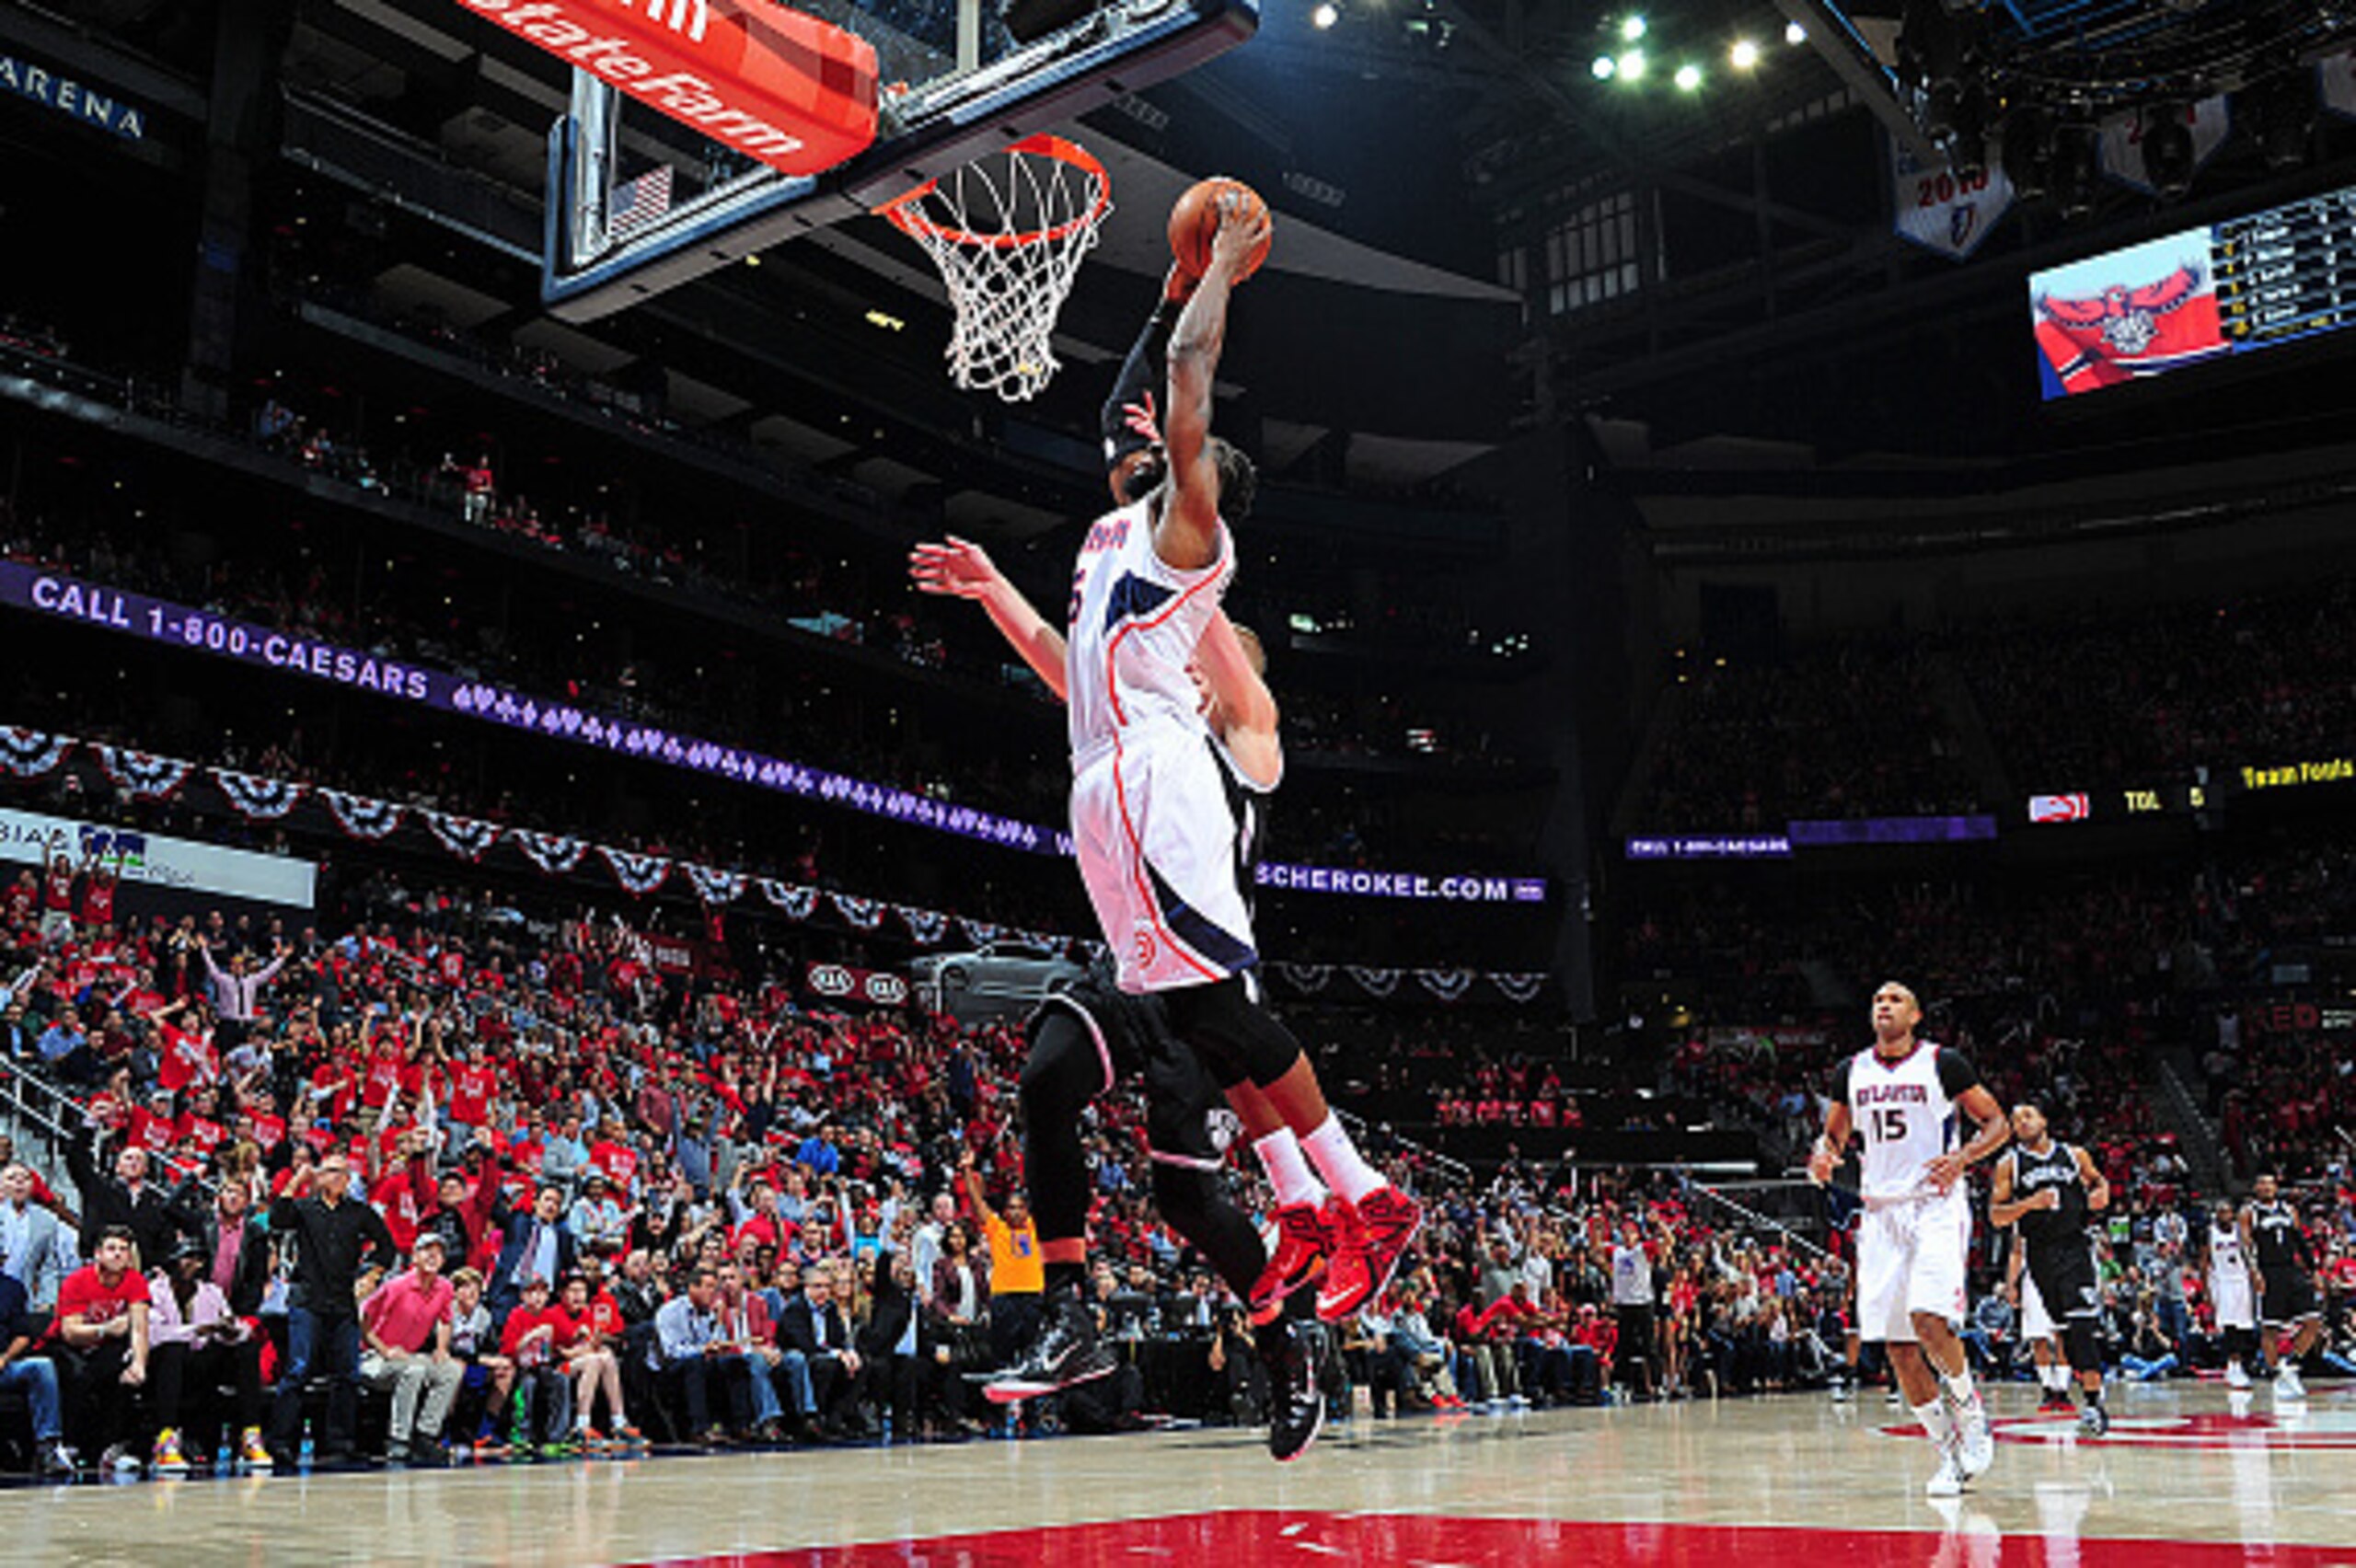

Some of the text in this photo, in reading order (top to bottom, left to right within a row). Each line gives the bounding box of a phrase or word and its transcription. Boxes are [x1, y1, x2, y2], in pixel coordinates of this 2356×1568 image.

[0, 55, 143, 138] ARENA
[629, 73, 803, 156] Farm
[31, 576, 430, 700] CALL 1-800-CAESARS
[1855, 1084, 1928, 1105] ATLANTA
[1873, 1109, 1907, 1143] 15
